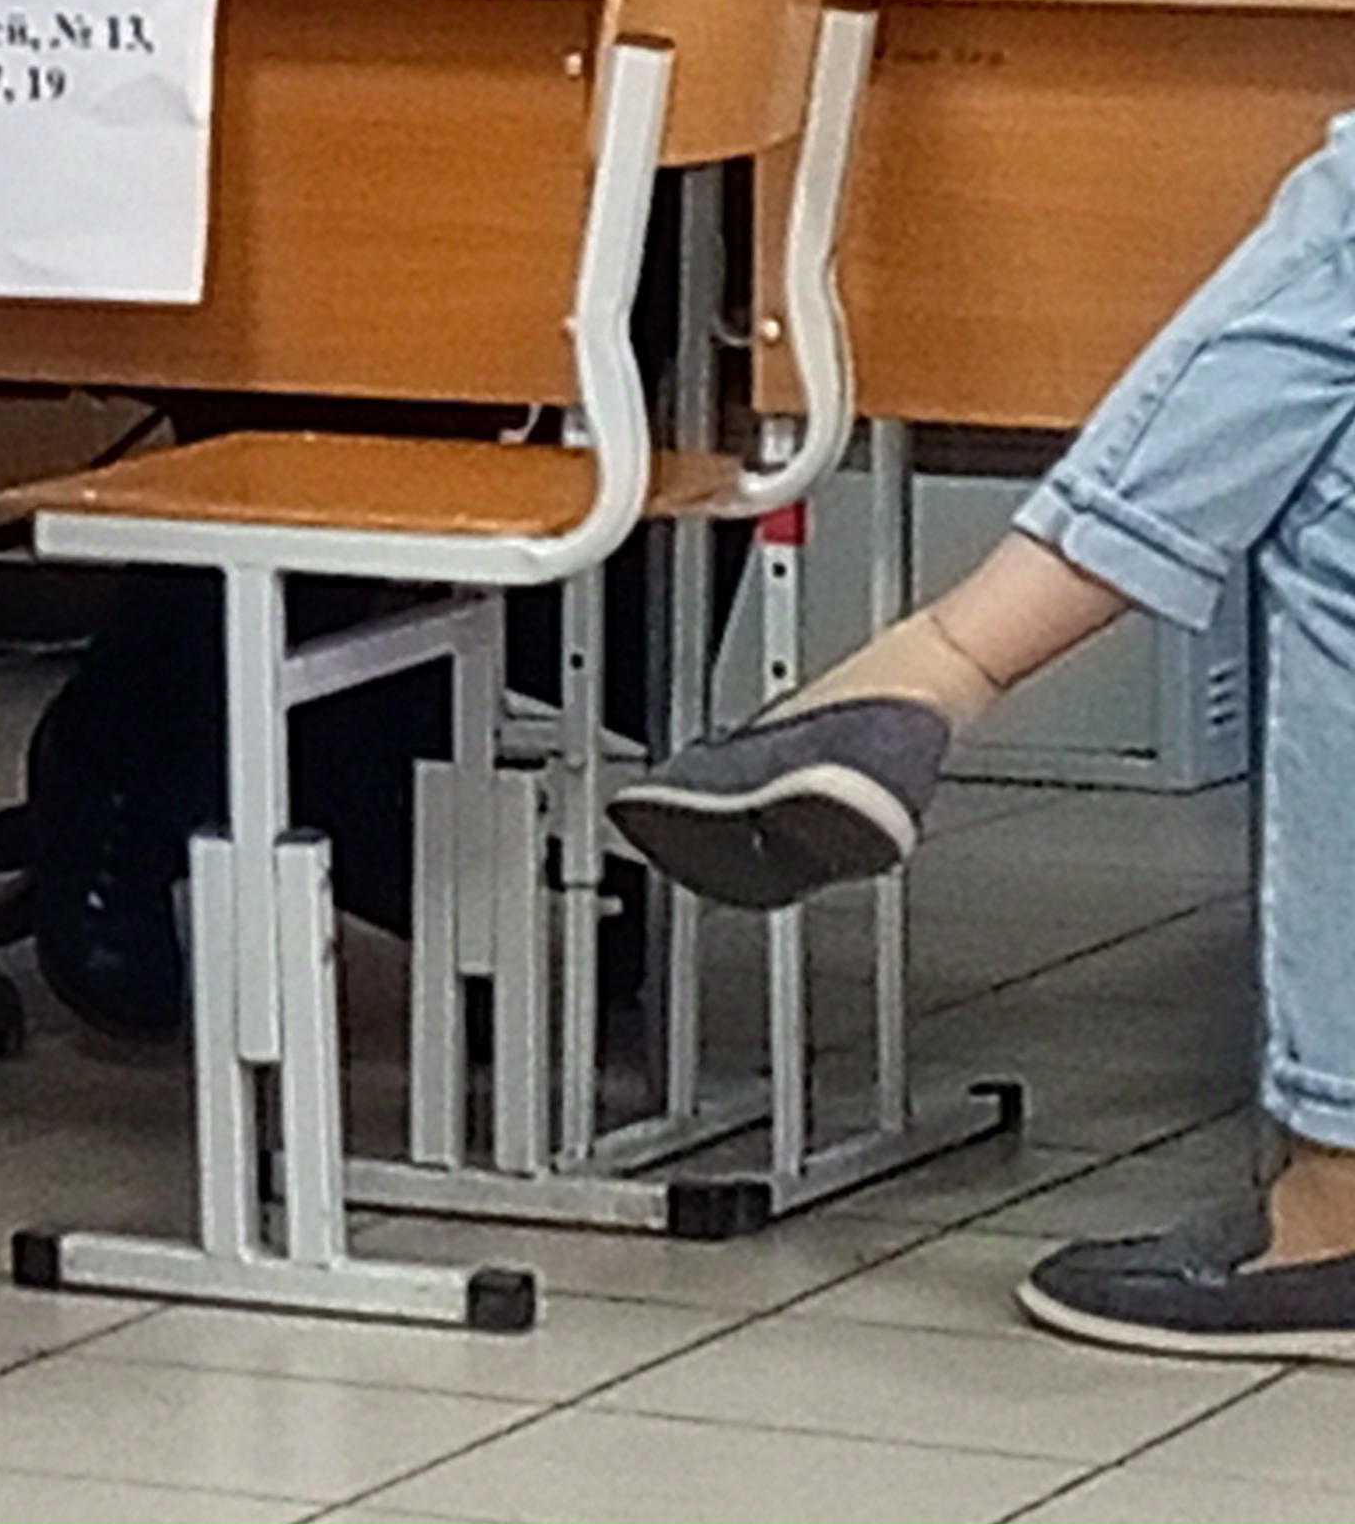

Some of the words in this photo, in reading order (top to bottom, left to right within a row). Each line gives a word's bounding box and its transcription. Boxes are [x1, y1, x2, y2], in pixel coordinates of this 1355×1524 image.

[49, 13, 93, 50] №
[107, 14, 155, 54] 13,
[27, 65, 66, 101] 19
